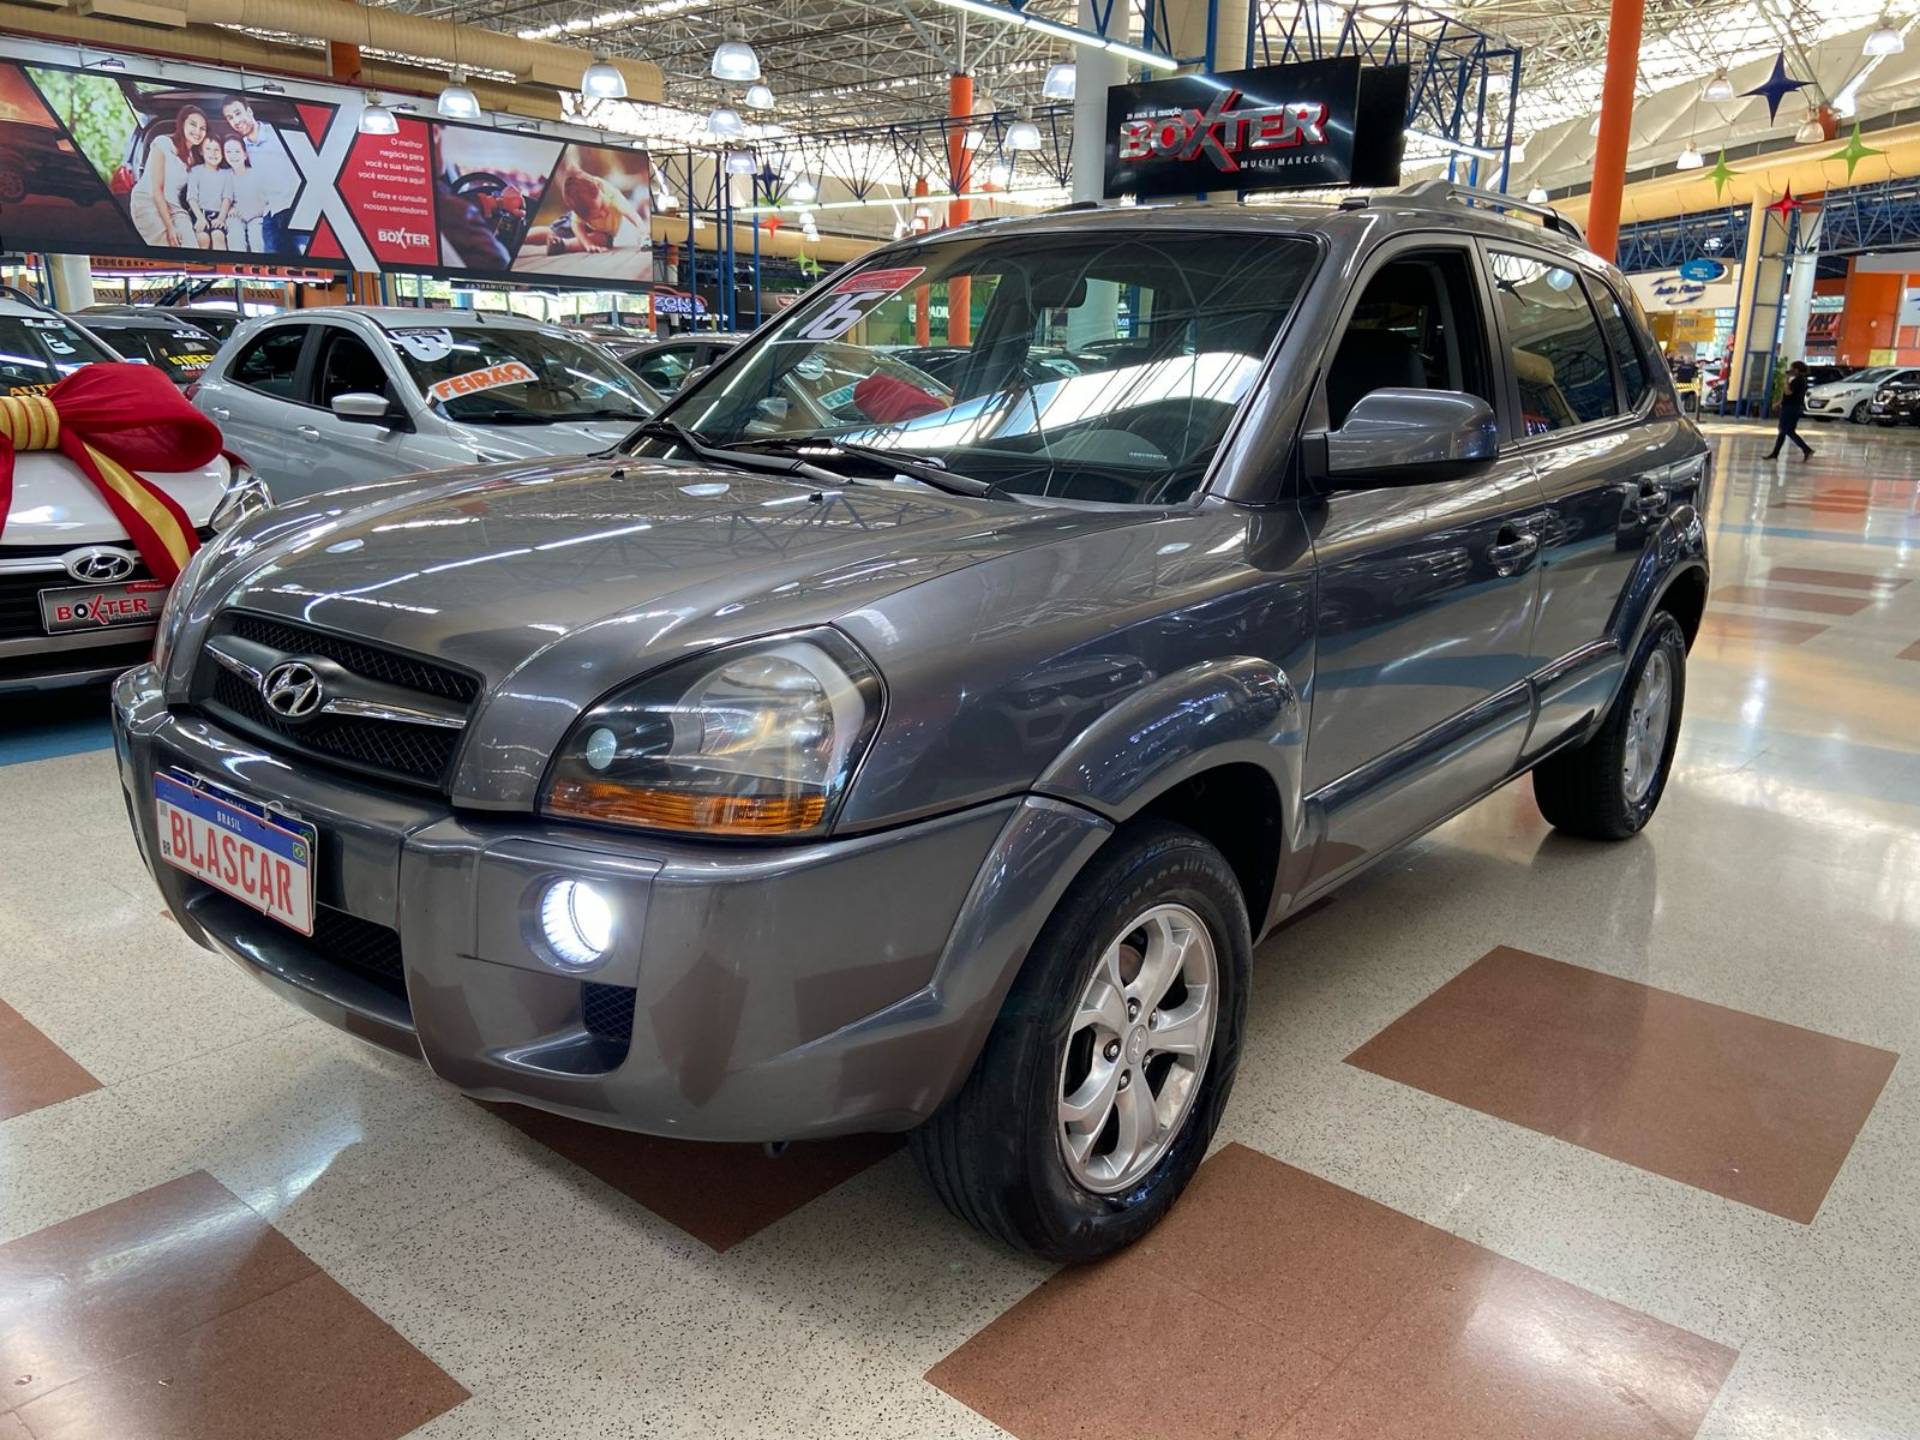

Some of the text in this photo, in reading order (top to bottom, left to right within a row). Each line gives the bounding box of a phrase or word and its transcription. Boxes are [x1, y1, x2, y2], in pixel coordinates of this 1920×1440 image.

[1120, 89, 1330, 173] BOXTER
[399, 140, 423, 149] melhor
[380, 150, 424, 162] negócio para
[1240, 154, 1326, 169] MULTIMARCAS
[365, 160, 382, 168] você
[358, 171, 376, 179] você
[377, 174, 408, 183] encontra
[372, 191, 391, 200] Entre
[398, 194, 427, 203] consulta
[364, 203, 428, 216] nossos vendedores
[377, 227, 430, 249] BOXTER
[797, 291, 888, 339] 16
[56, 593, 149, 625] BOXTER
[216, 811, 242, 832] BRASIL
[170, 810, 294, 916] BLASCAR
